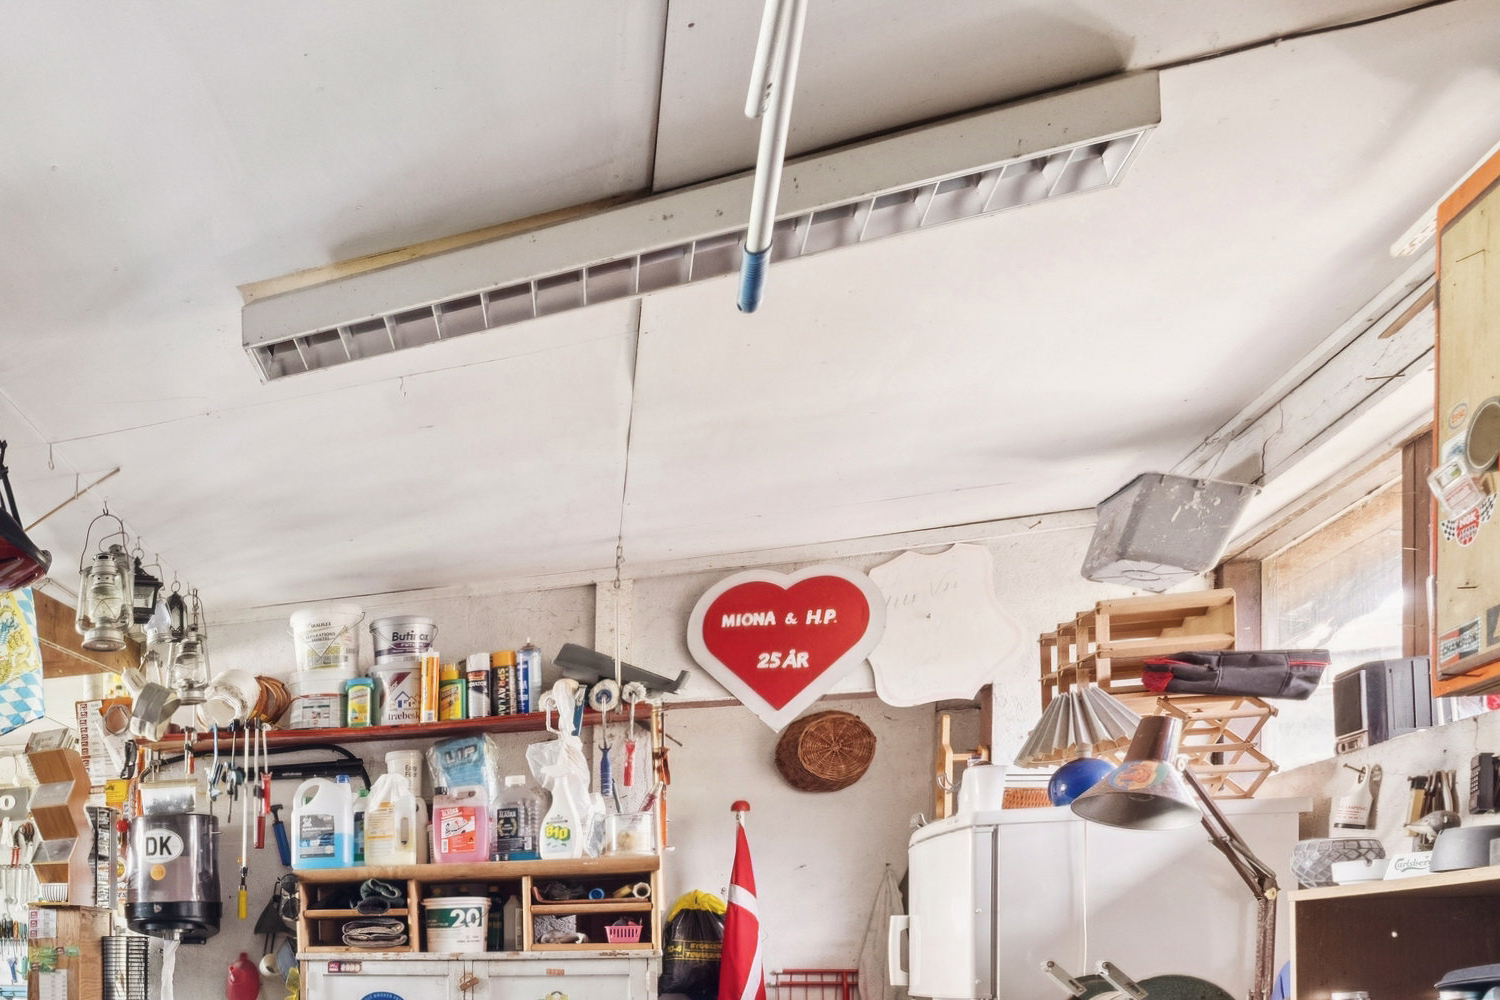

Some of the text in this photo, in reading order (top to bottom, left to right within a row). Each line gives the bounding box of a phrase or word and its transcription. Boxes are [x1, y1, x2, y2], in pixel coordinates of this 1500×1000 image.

[721, 610, 776, 628] MIONA
[785, 612, 798, 625] &
[757, 649, 809, 669] 25 ÅR
[444, 744, 478, 764] LIP
[145, 835, 172, 856] DK
[450, 908, 481, 928] 20
